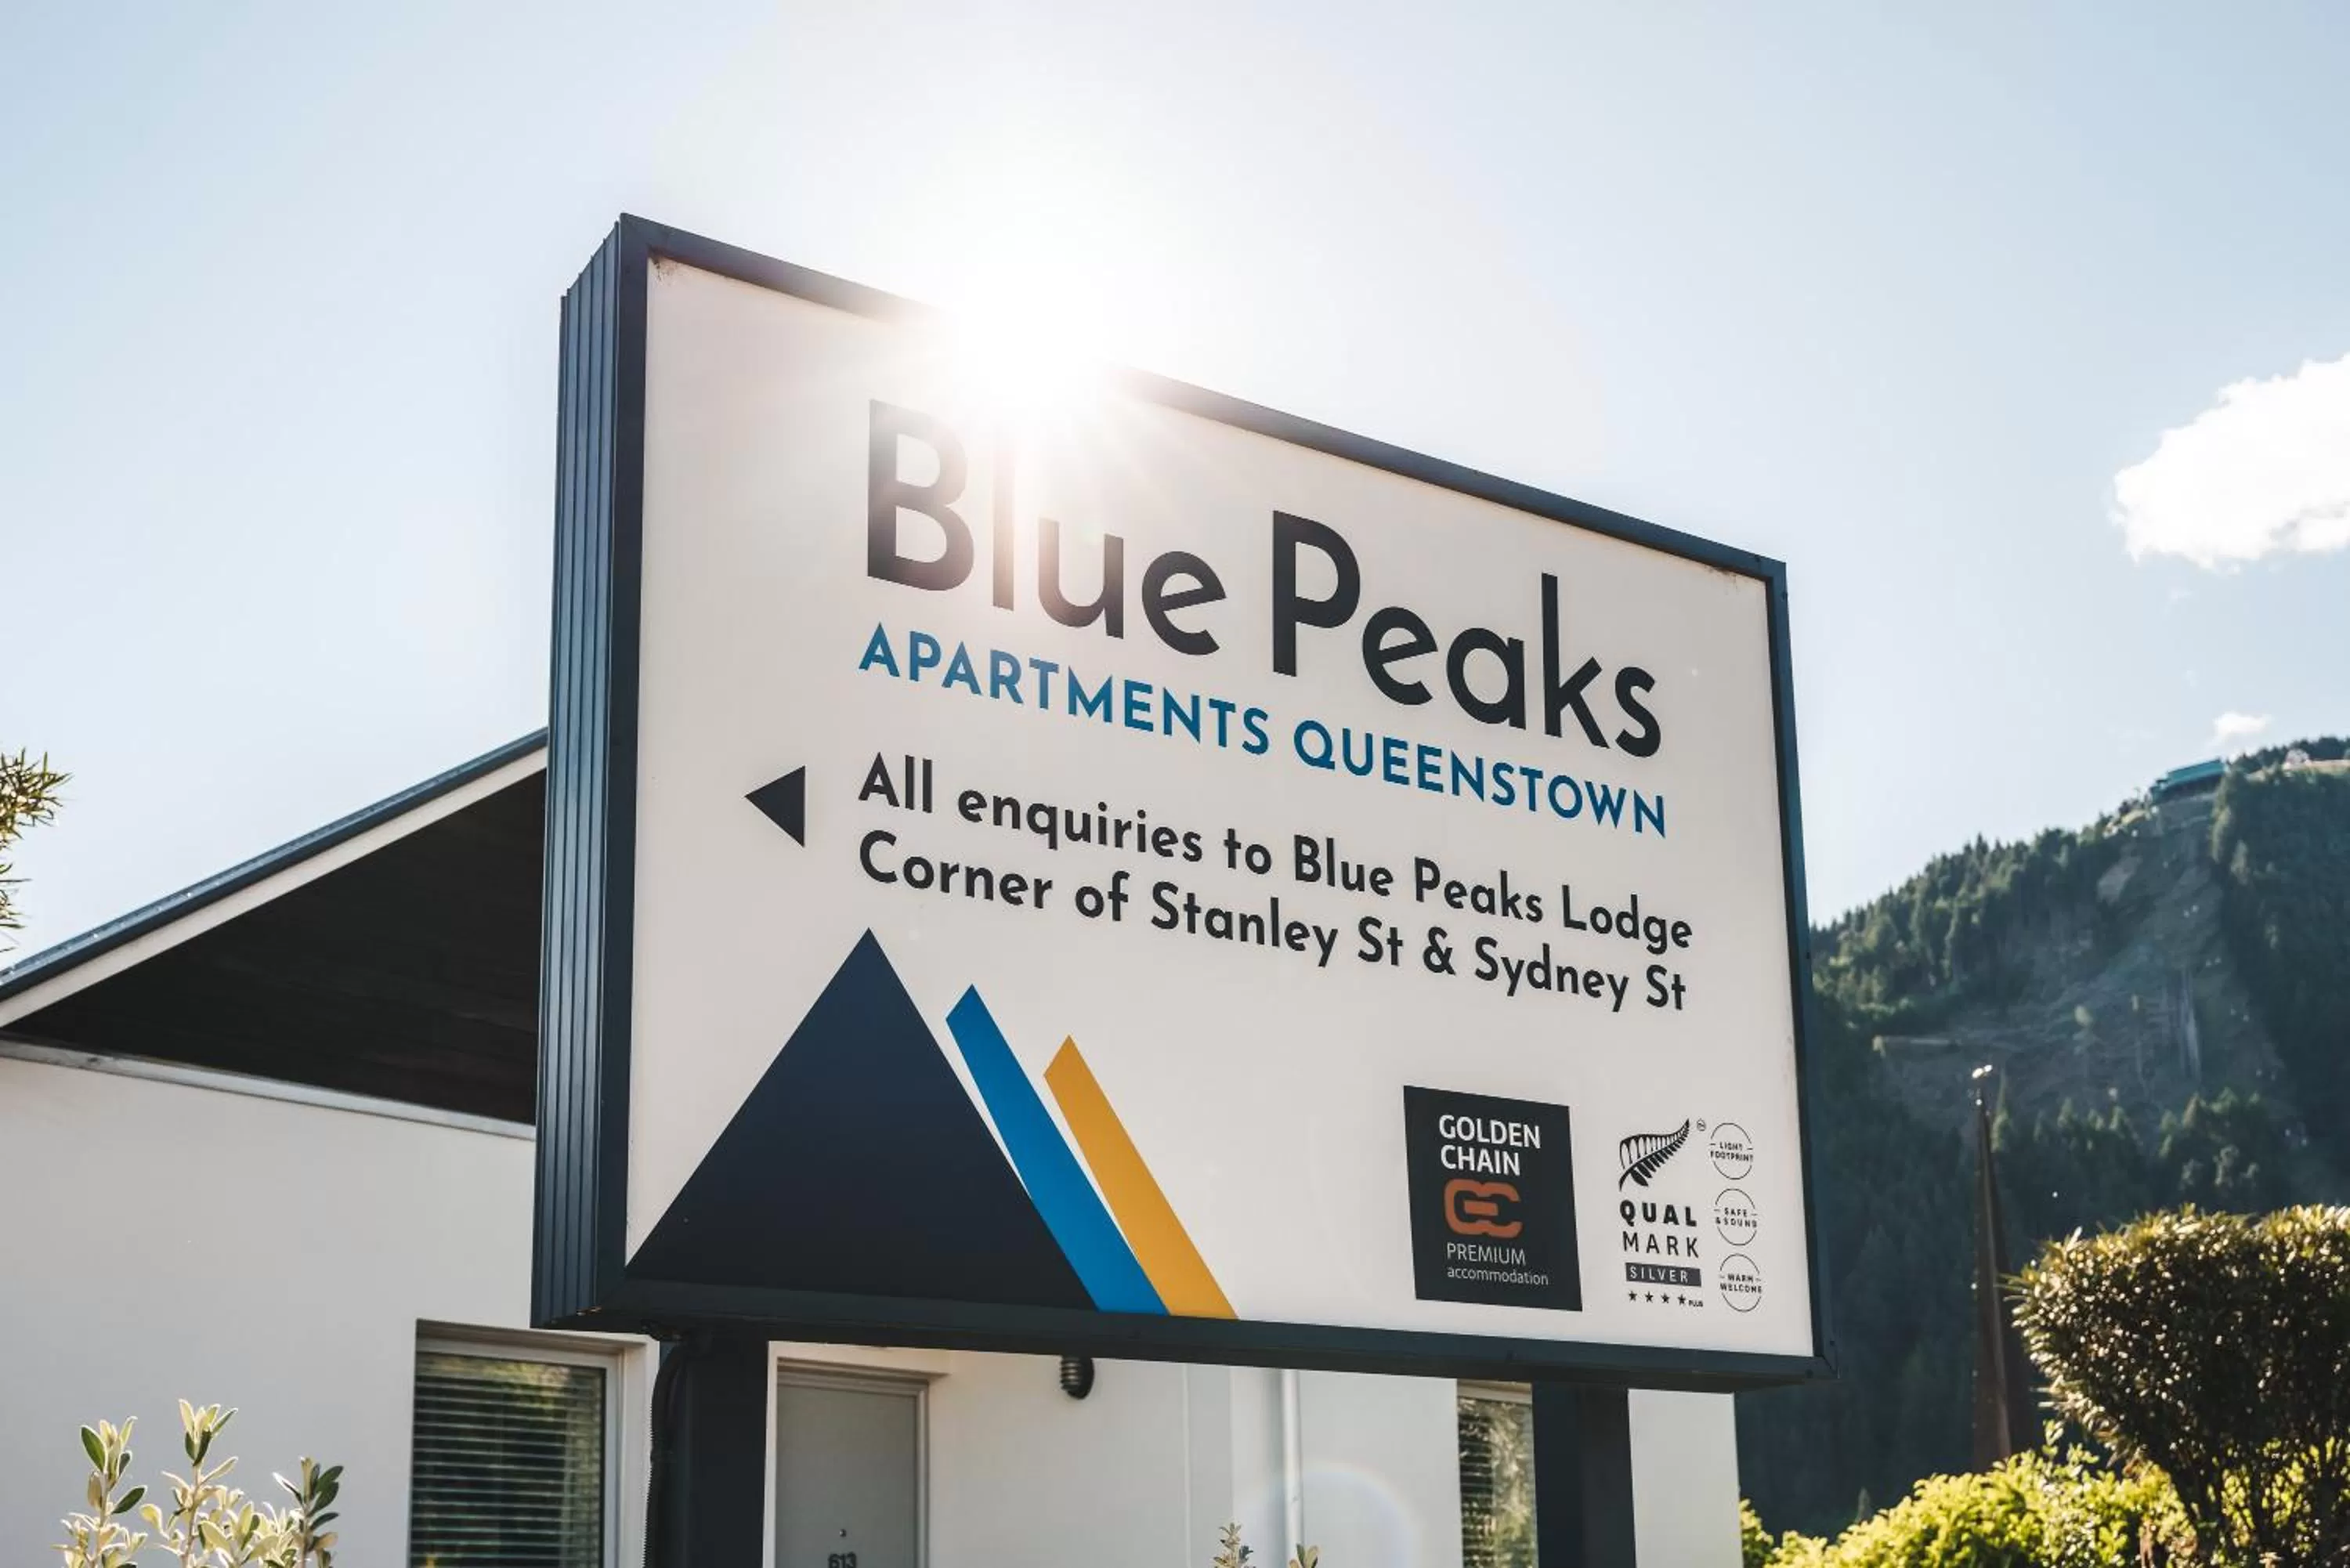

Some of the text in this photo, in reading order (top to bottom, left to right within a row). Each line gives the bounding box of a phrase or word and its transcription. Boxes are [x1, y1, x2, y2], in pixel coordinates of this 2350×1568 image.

[867, 399, 1661, 757] Blue Peaks
[859, 622, 1666, 838] APARTMENTS QUEENSTOWN
[859, 752, 1693, 955] All enquiries to Blue Peaks Lodge
[859, 829, 1687, 1013] Corner of Stanley St & Sydney St
[1438, 1114, 1541, 1149] GOLDEN
[1710, 1151, 1754, 1162] FOOTPRINT
[1719, 1141, 1743, 1151] LIGHT
[1441, 1144, 1520, 1176] CHAIN
[1619, 1199, 1697, 1227] QUAL
[1724, 1207, 1748, 1217] SAFE
[1447, 1242, 1526, 1266] PREMIUM
[1622, 1230, 1699, 1258] MARK
[1448, 1266, 1549, 1285] accommodation
[1630, 1266, 1689, 1284] SILVER
[1719, 1283, 1762, 1293] WELCOME
[1727, 1274, 1754, 1282] WARM
